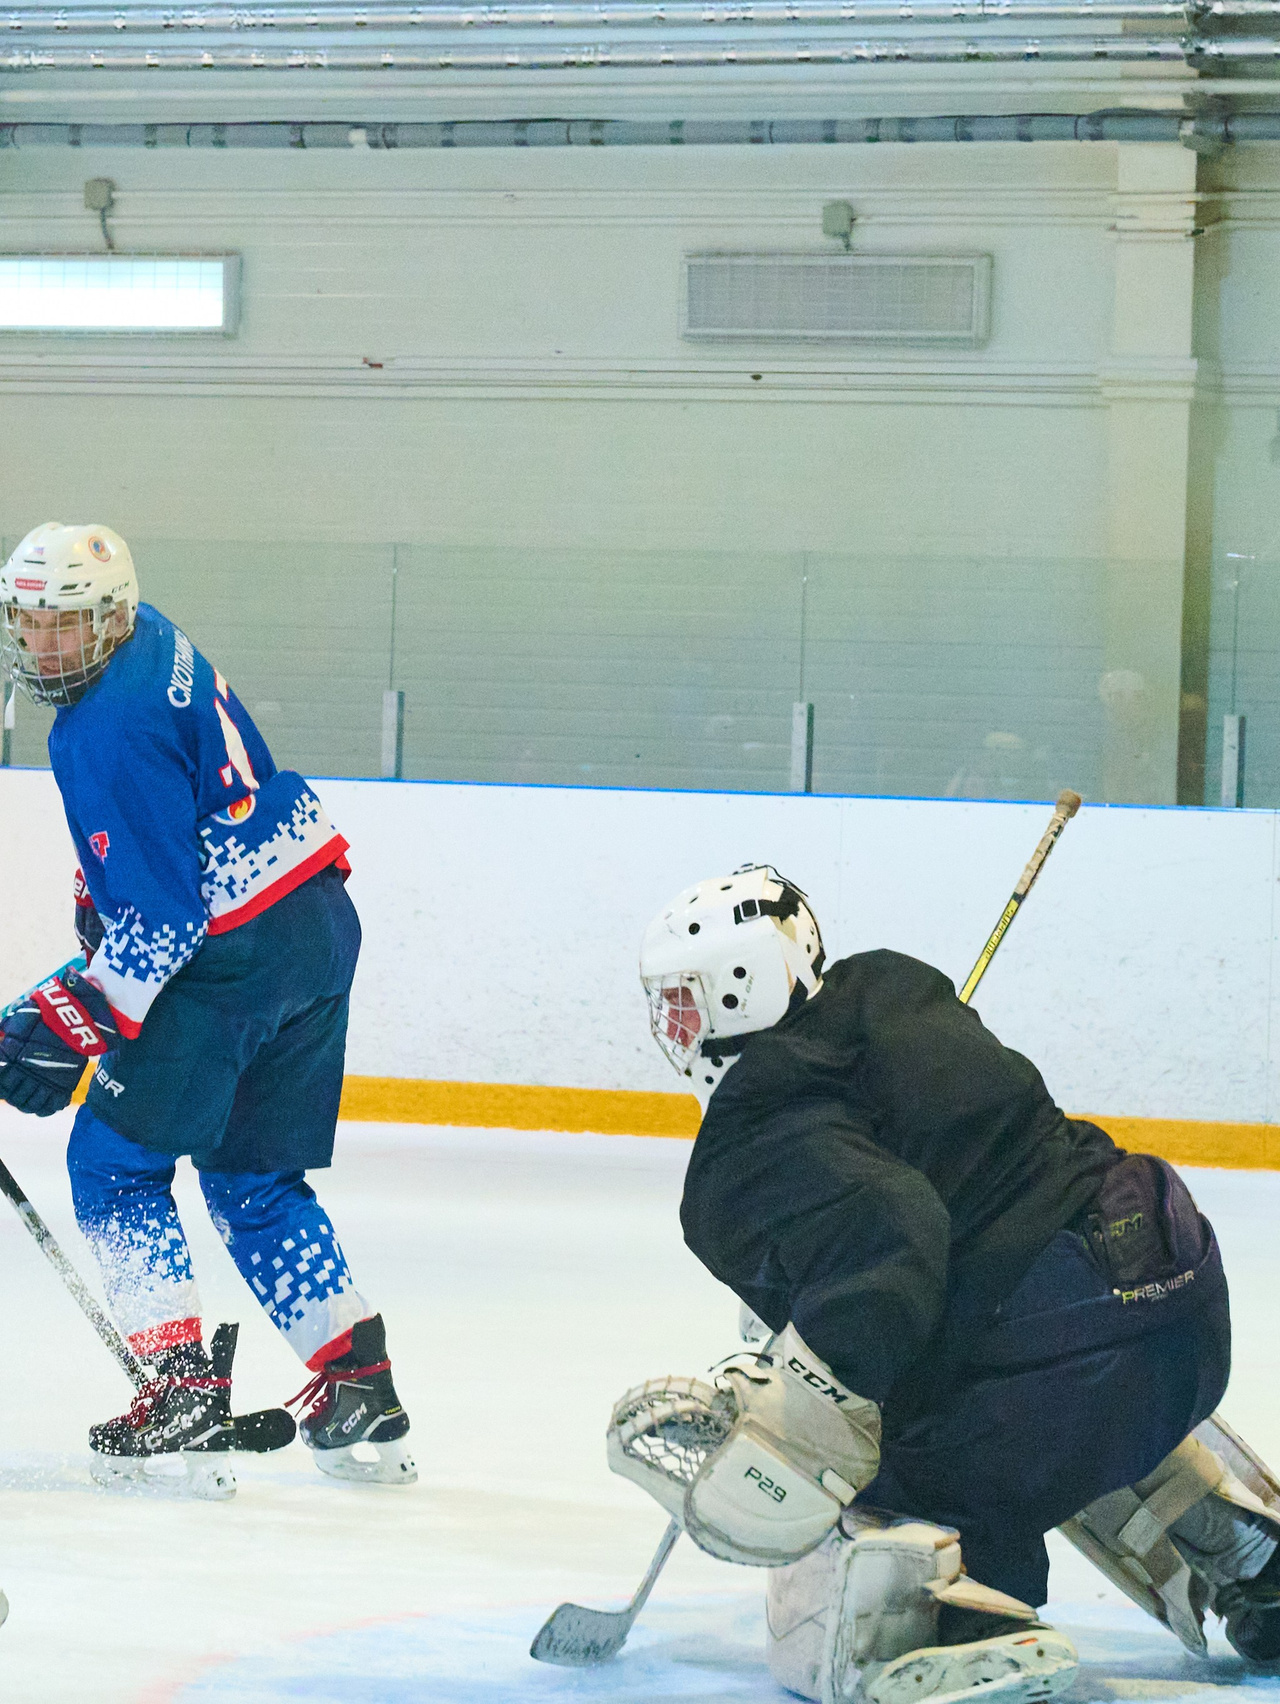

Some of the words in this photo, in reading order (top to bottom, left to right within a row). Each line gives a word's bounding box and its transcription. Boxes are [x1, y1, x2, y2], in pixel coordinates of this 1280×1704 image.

[1122, 1270, 1194, 1305] PREMIER
[788, 1356, 848, 1404] CCM
[341, 1402, 368, 1434] CCM
[744, 1466, 787, 1503] P29
